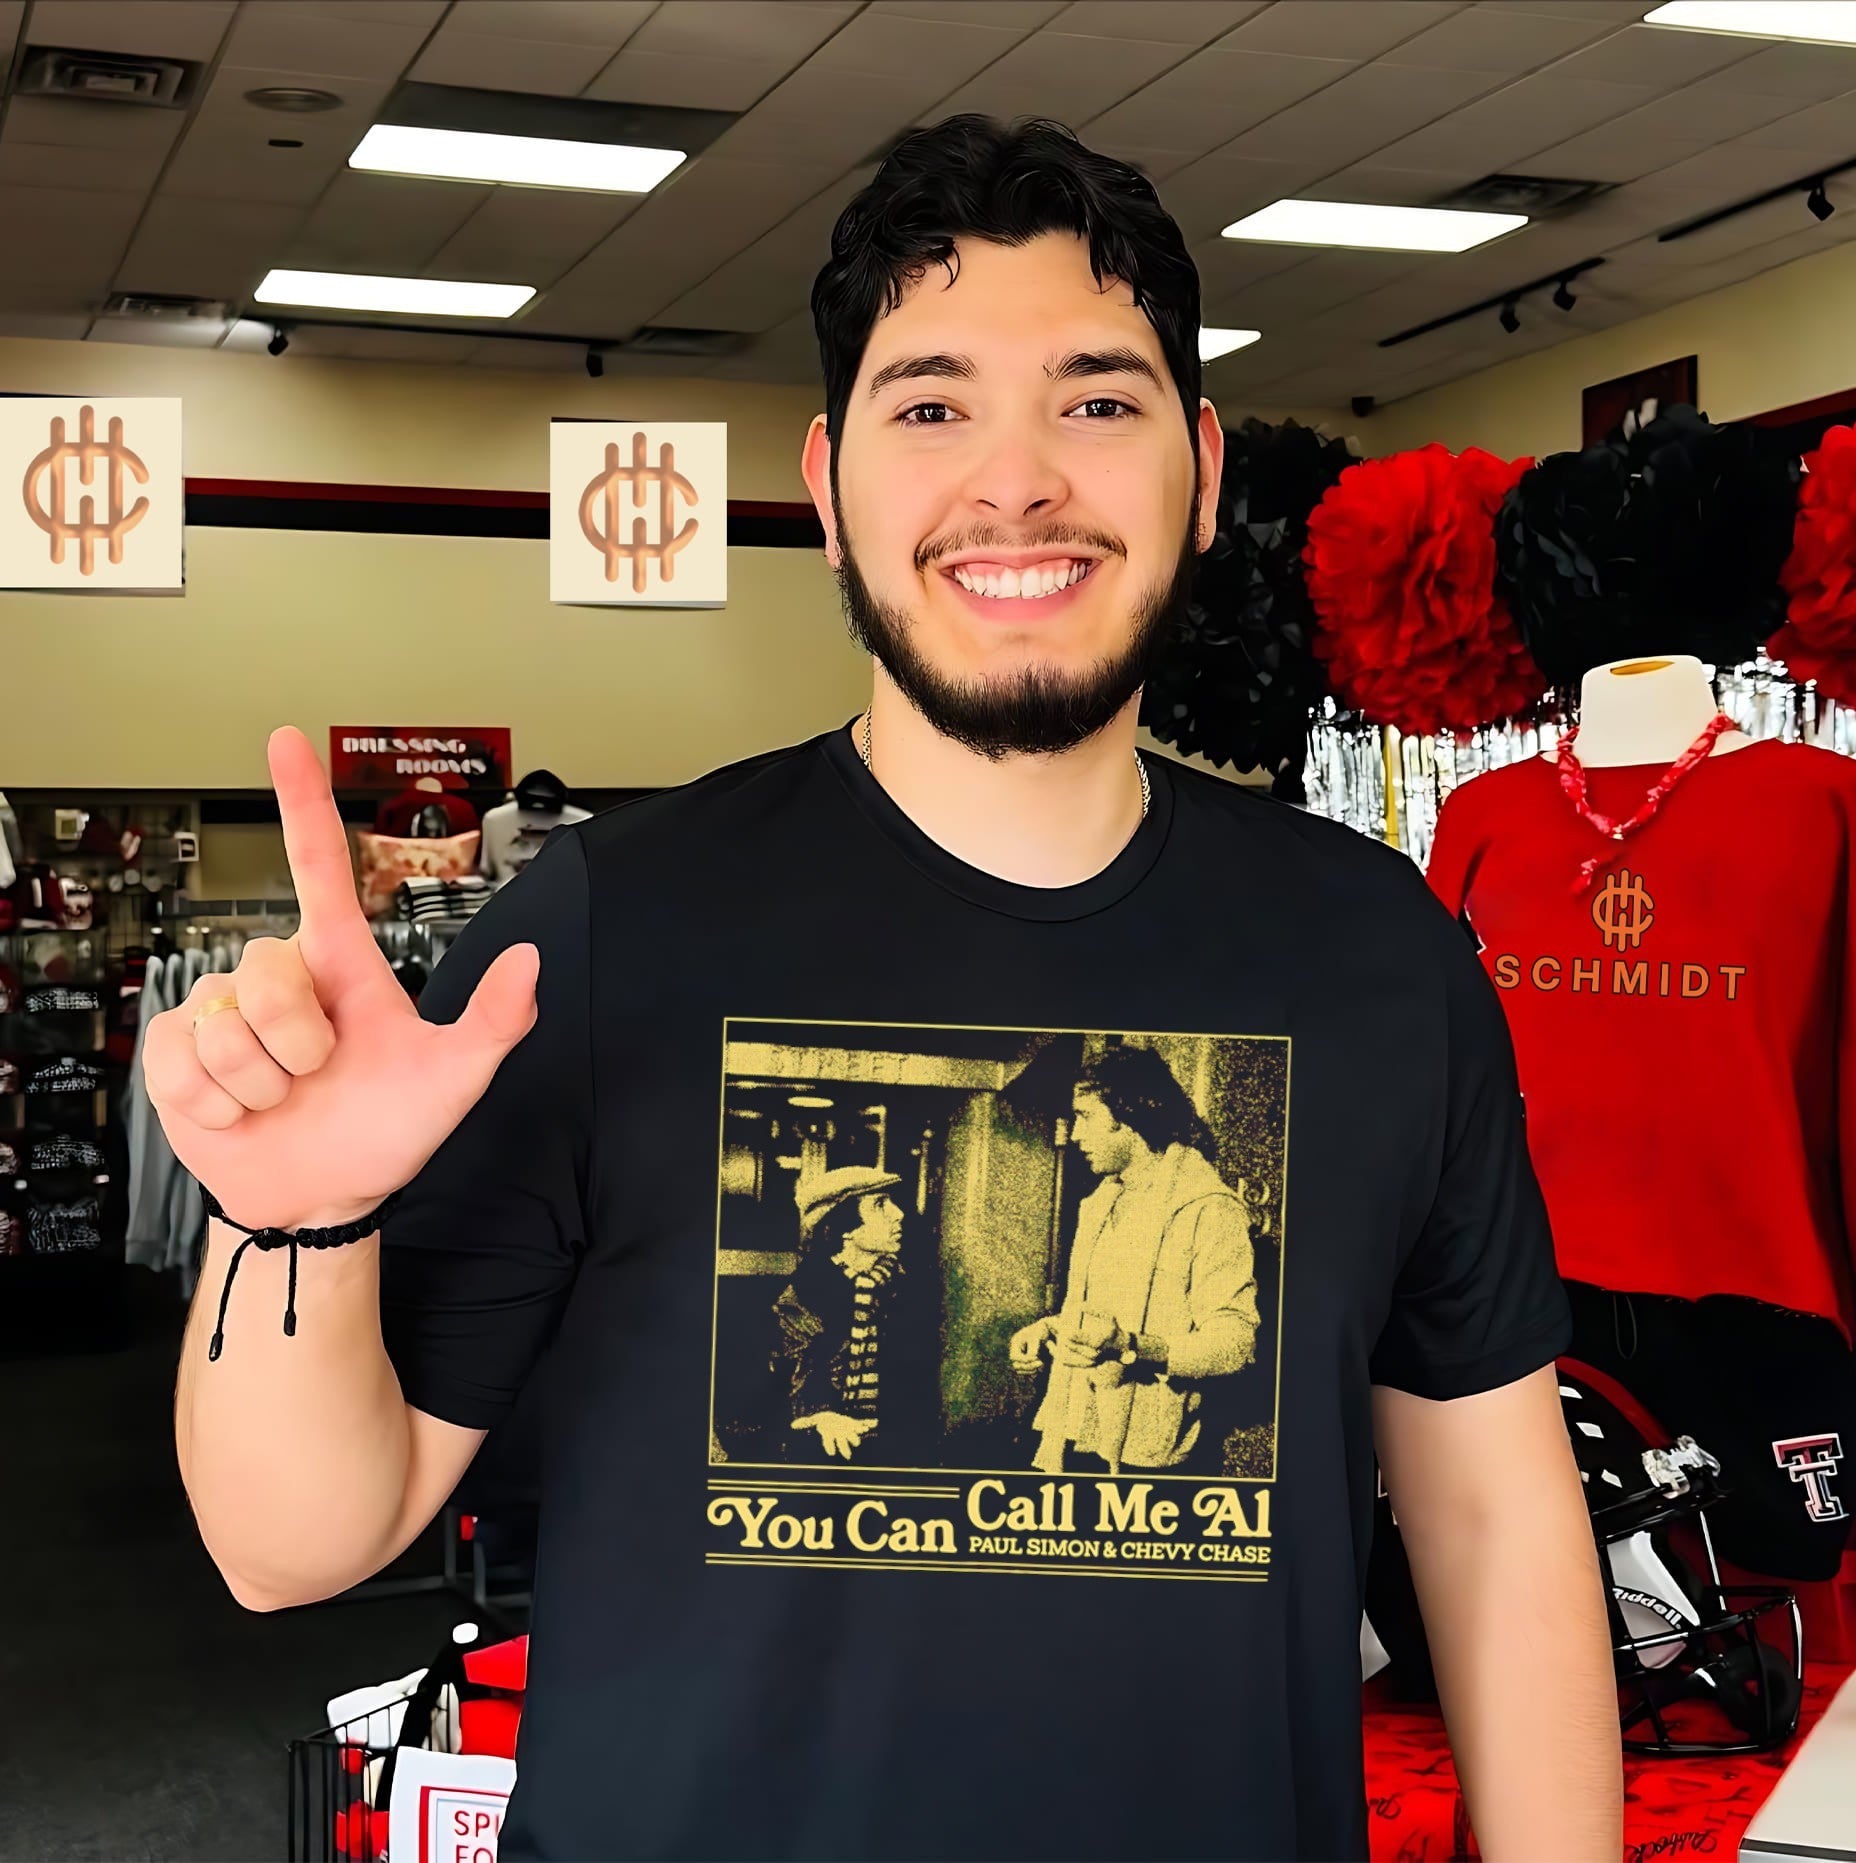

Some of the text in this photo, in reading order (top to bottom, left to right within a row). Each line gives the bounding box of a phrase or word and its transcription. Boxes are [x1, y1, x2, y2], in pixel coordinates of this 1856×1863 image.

[342, 738, 467, 754] DRESSING
[396, 758, 487, 775] ROOMS
[1494, 953, 1748, 1001] SCHMIDT
[707, 1479, 1272, 1554] You Can Call Me Al
[969, 1536, 1272, 1564] PAUL SIMON & CHEVY CHASE
